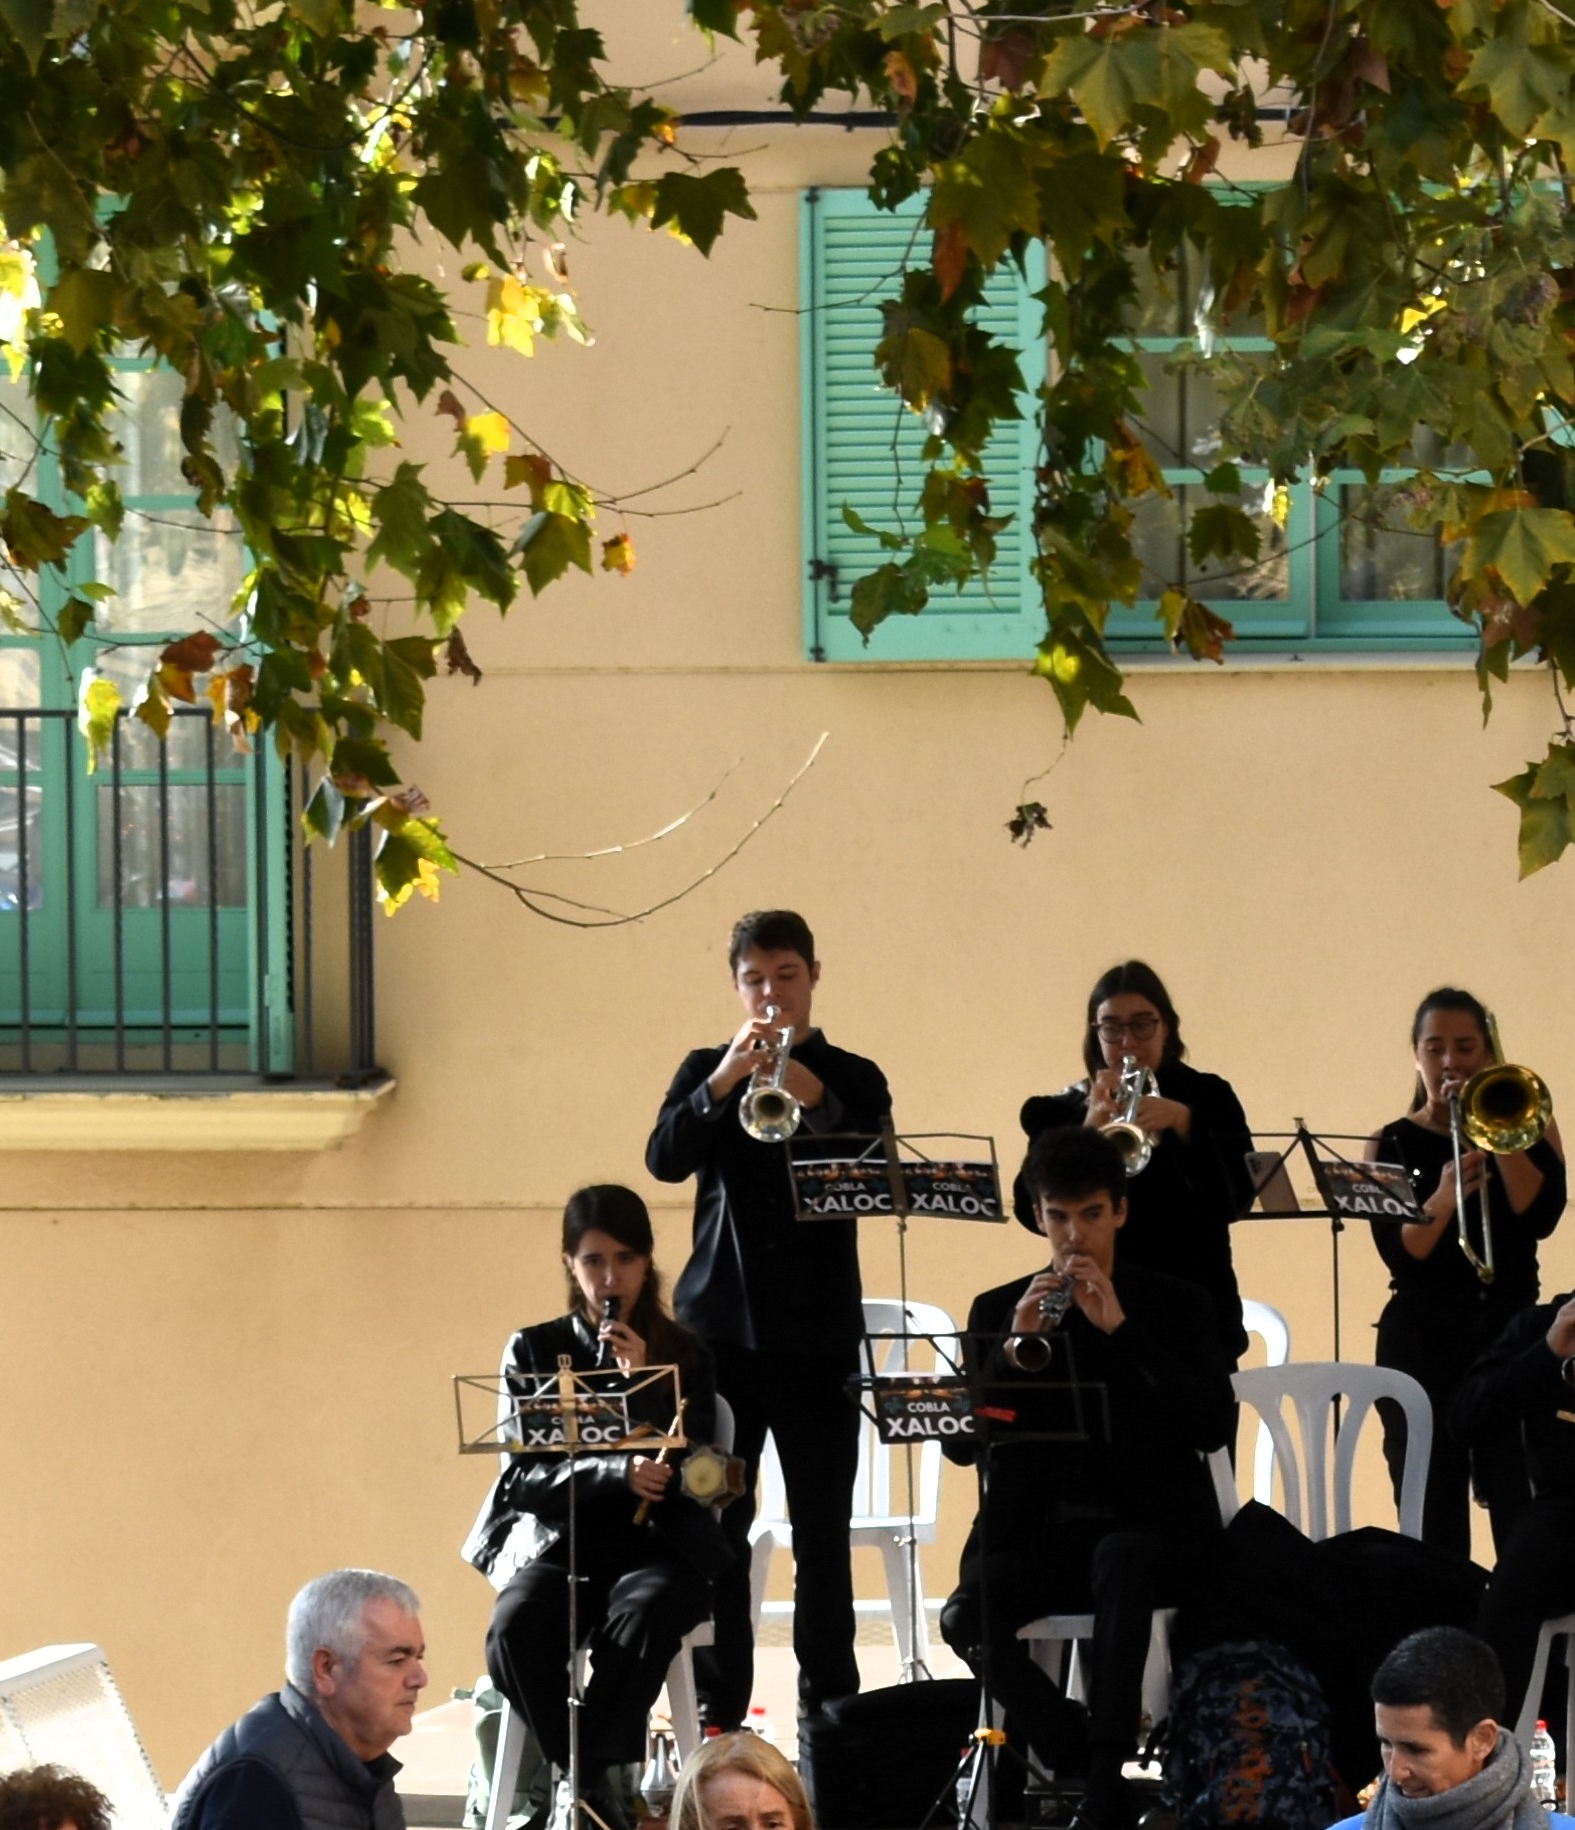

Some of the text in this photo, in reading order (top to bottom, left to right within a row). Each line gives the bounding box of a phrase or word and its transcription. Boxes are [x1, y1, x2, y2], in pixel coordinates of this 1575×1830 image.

[907, 1402, 951, 1413] COBLA
[528, 1425, 621, 1446] XAOC
[885, 1415, 975, 1437] XALOC
